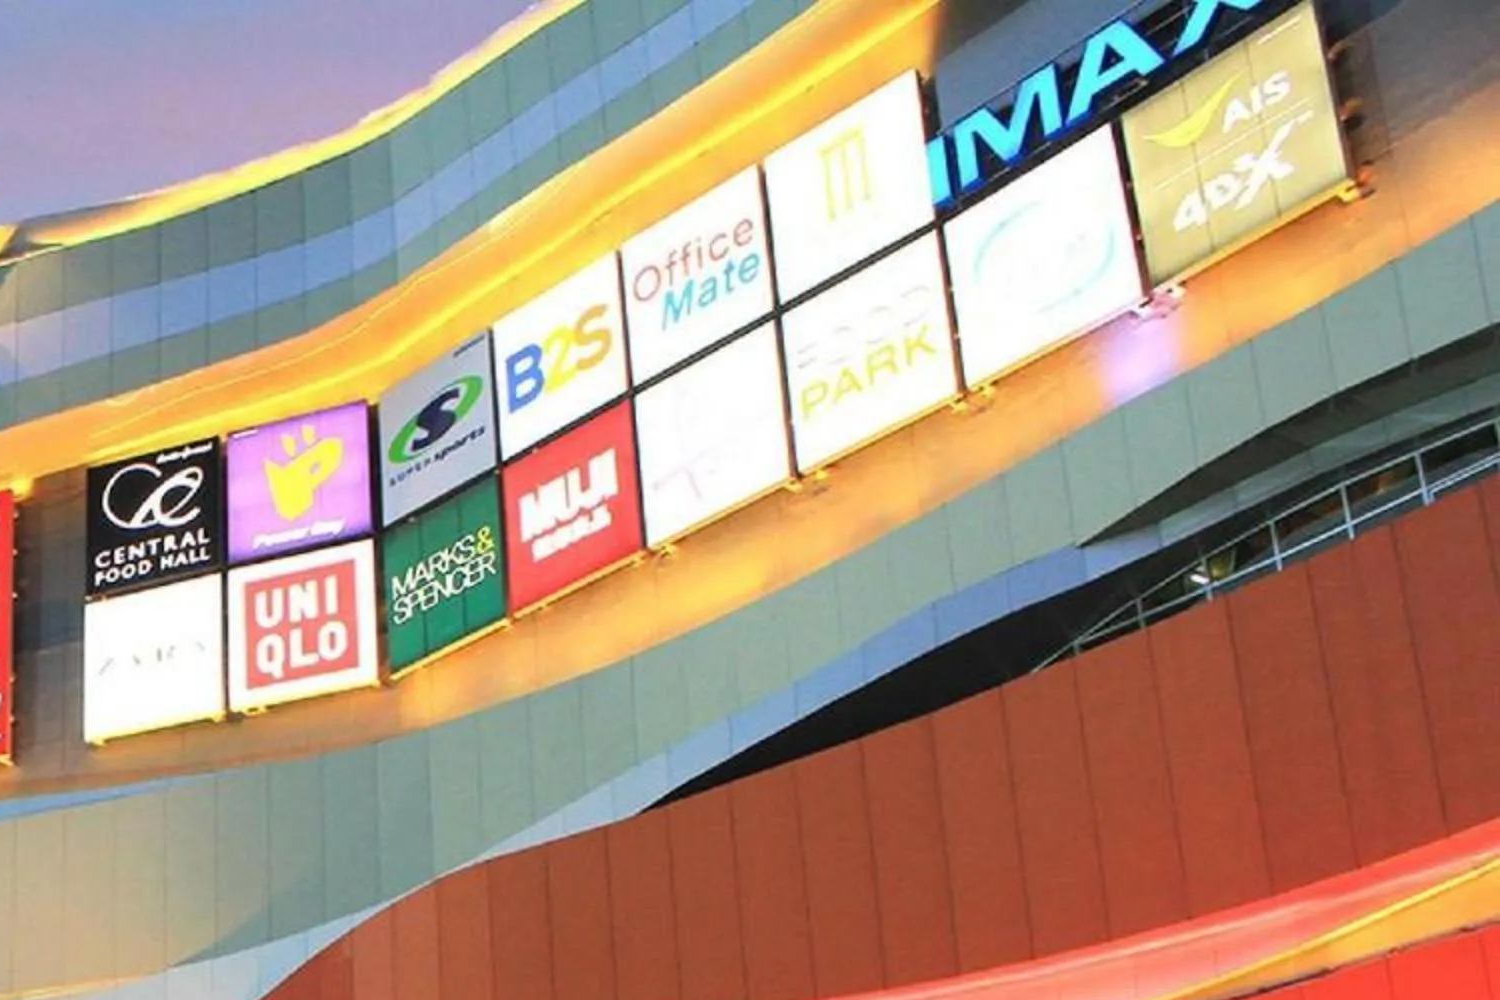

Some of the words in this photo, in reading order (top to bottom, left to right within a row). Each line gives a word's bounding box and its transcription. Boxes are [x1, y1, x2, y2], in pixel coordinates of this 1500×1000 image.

[926, 0, 1262, 207] IMAX
[1223, 70, 1291, 133] AIS
[1173, 110, 1302, 232] 4DX
[633, 218, 754, 302] Office
[662, 252, 760, 331] Mate
[505, 303, 613, 414] B2S
[799, 322, 938, 421] PARK
[93, 559, 153, 588] FOOD
[160, 546, 211, 571] HALL
[94, 528, 211, 569] CENTRAL
[254, 575, 338, 628] UNI
[393, 551, 497, 625] SPENCER
[256, 619, 348, 679] QLO
